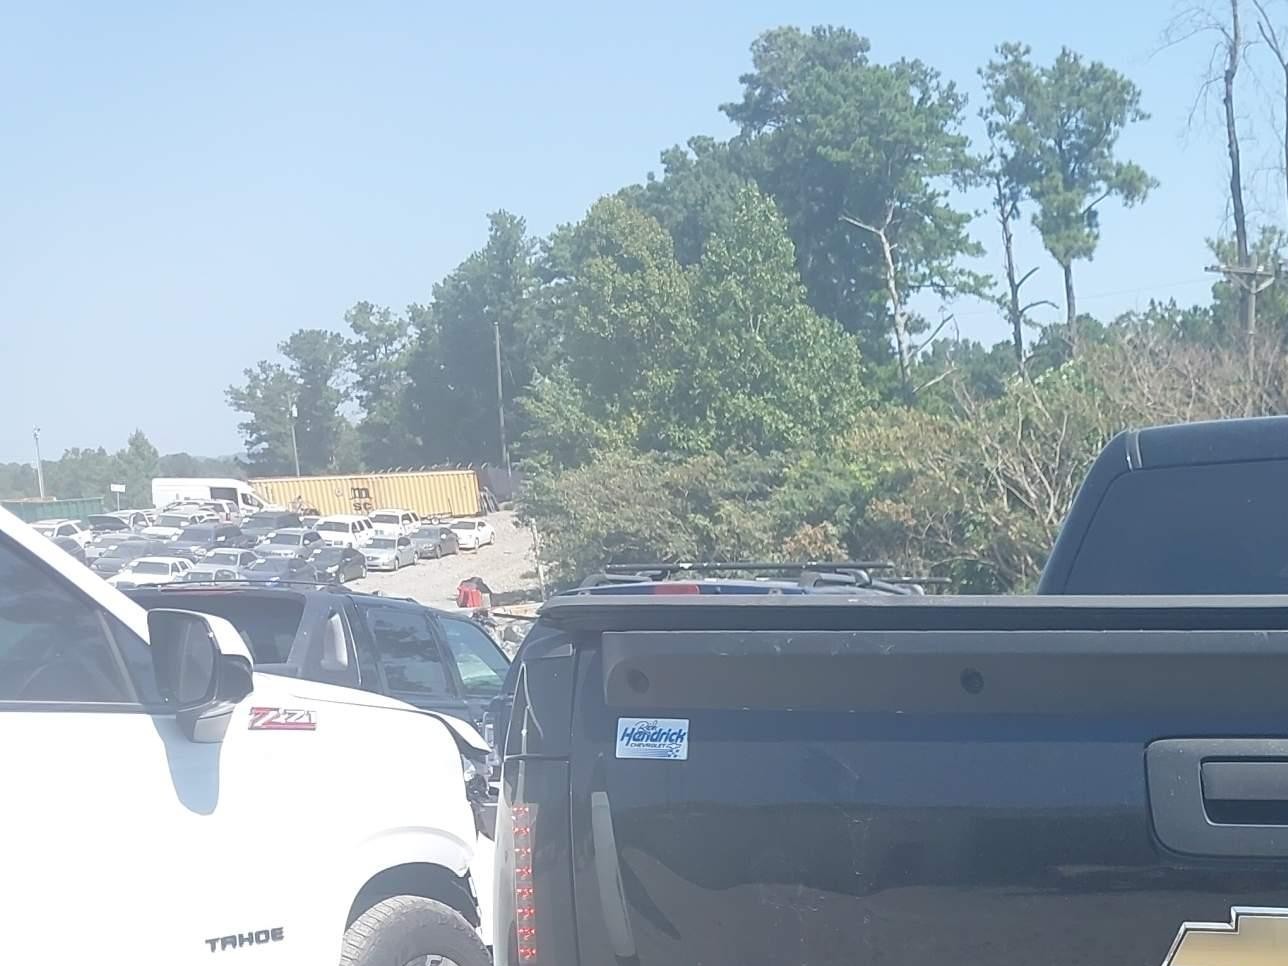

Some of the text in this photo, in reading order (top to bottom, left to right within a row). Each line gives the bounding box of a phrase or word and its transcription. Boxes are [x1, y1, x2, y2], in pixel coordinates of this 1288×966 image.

[248, 707, 318, 730] Z71
[620, 727, 687, 747] Hendrick
[204, 926, 285, 953] TAHOE
